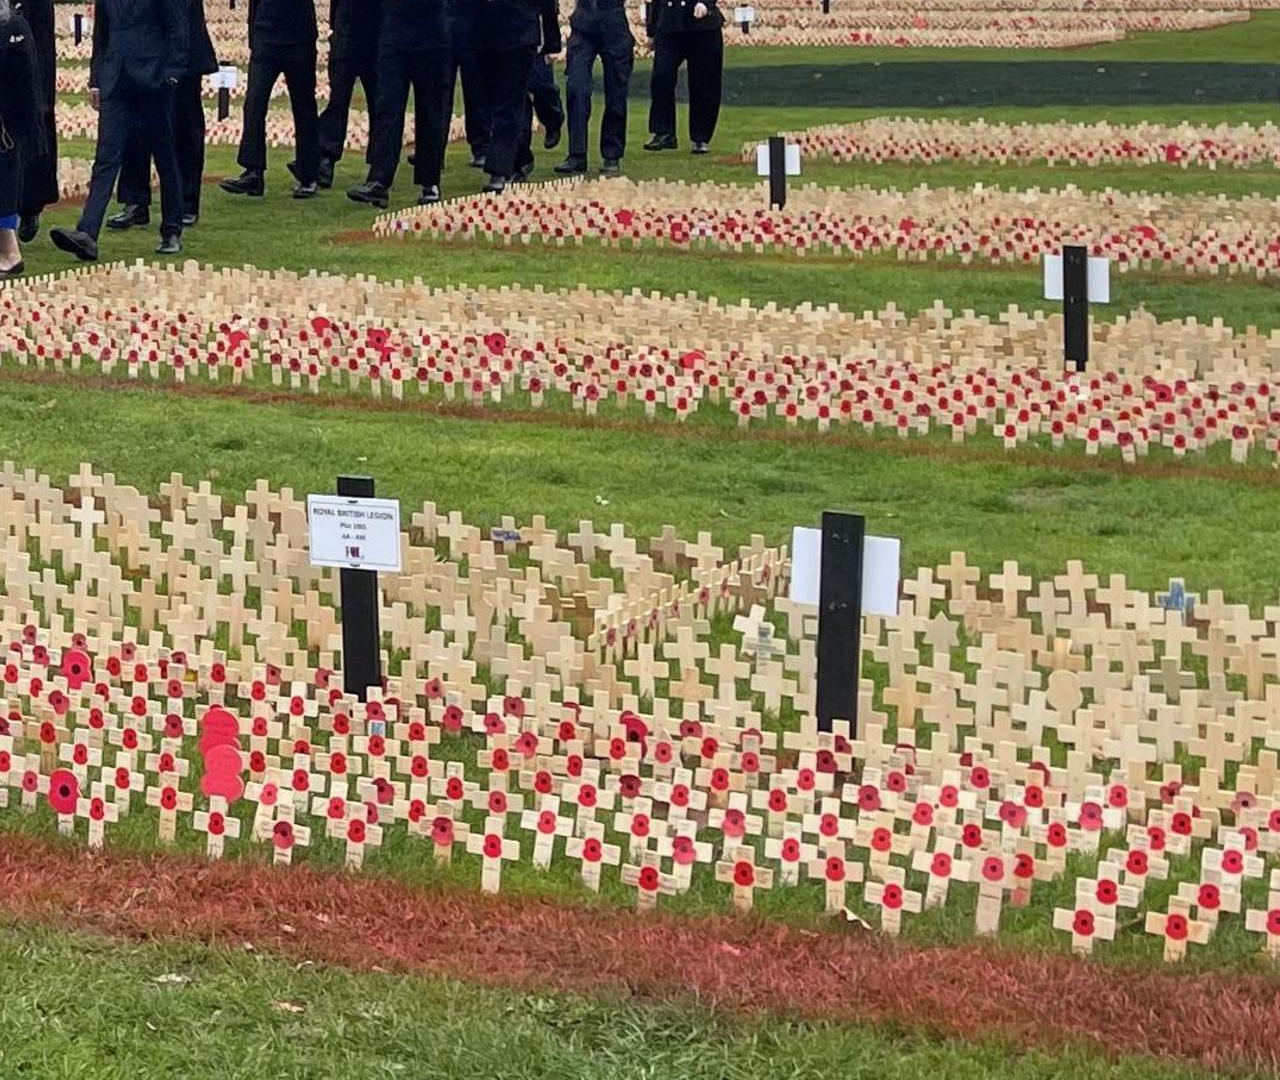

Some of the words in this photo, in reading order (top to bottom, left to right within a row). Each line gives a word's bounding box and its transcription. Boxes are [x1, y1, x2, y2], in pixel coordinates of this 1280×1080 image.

[313, 508, 335, 516] ROYAL
[337, 509, 365, 518] BRITISH
[367, 511, 394, 520] LEGION
